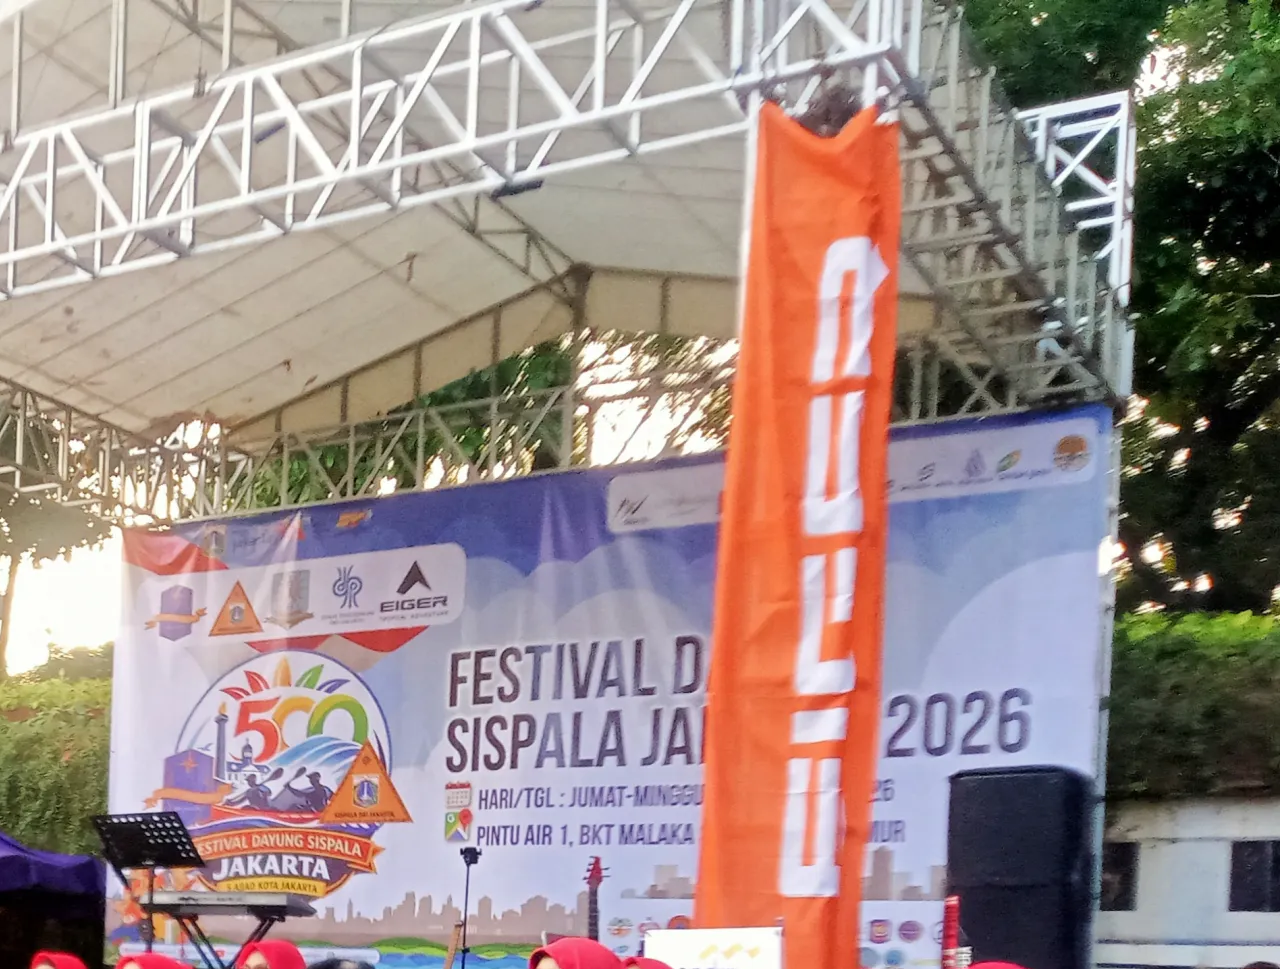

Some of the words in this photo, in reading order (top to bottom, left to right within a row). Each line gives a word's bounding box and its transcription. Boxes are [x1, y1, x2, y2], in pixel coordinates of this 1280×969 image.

[379, 595, 449, 613] EIGER
[448, 638, 657, 707] FESTIVAL
[886, 687, 1033, 758] 2026
[445, 709, 627, 773] SISPALA
[478, 786, 555, 810] HARI/TGL
[198, 836, 248, 856] ESTIVAL
[251, 833, 304, 849] DAYUNG
[307, 835, 362, 858] SISPALA
[476, 824, 521, 847] PINTU
[524, 824, 553, 846] AIR
[560, 824, 574, 848] 1,
[578, 823, 616, 846] BKT
[618, 822, 696, 846] MALAKA
[212, 854, 331, 881] JAKARTA
[258, 880, 280, 891] KOTA
[280, 880, 318, 894] JAKARTA
